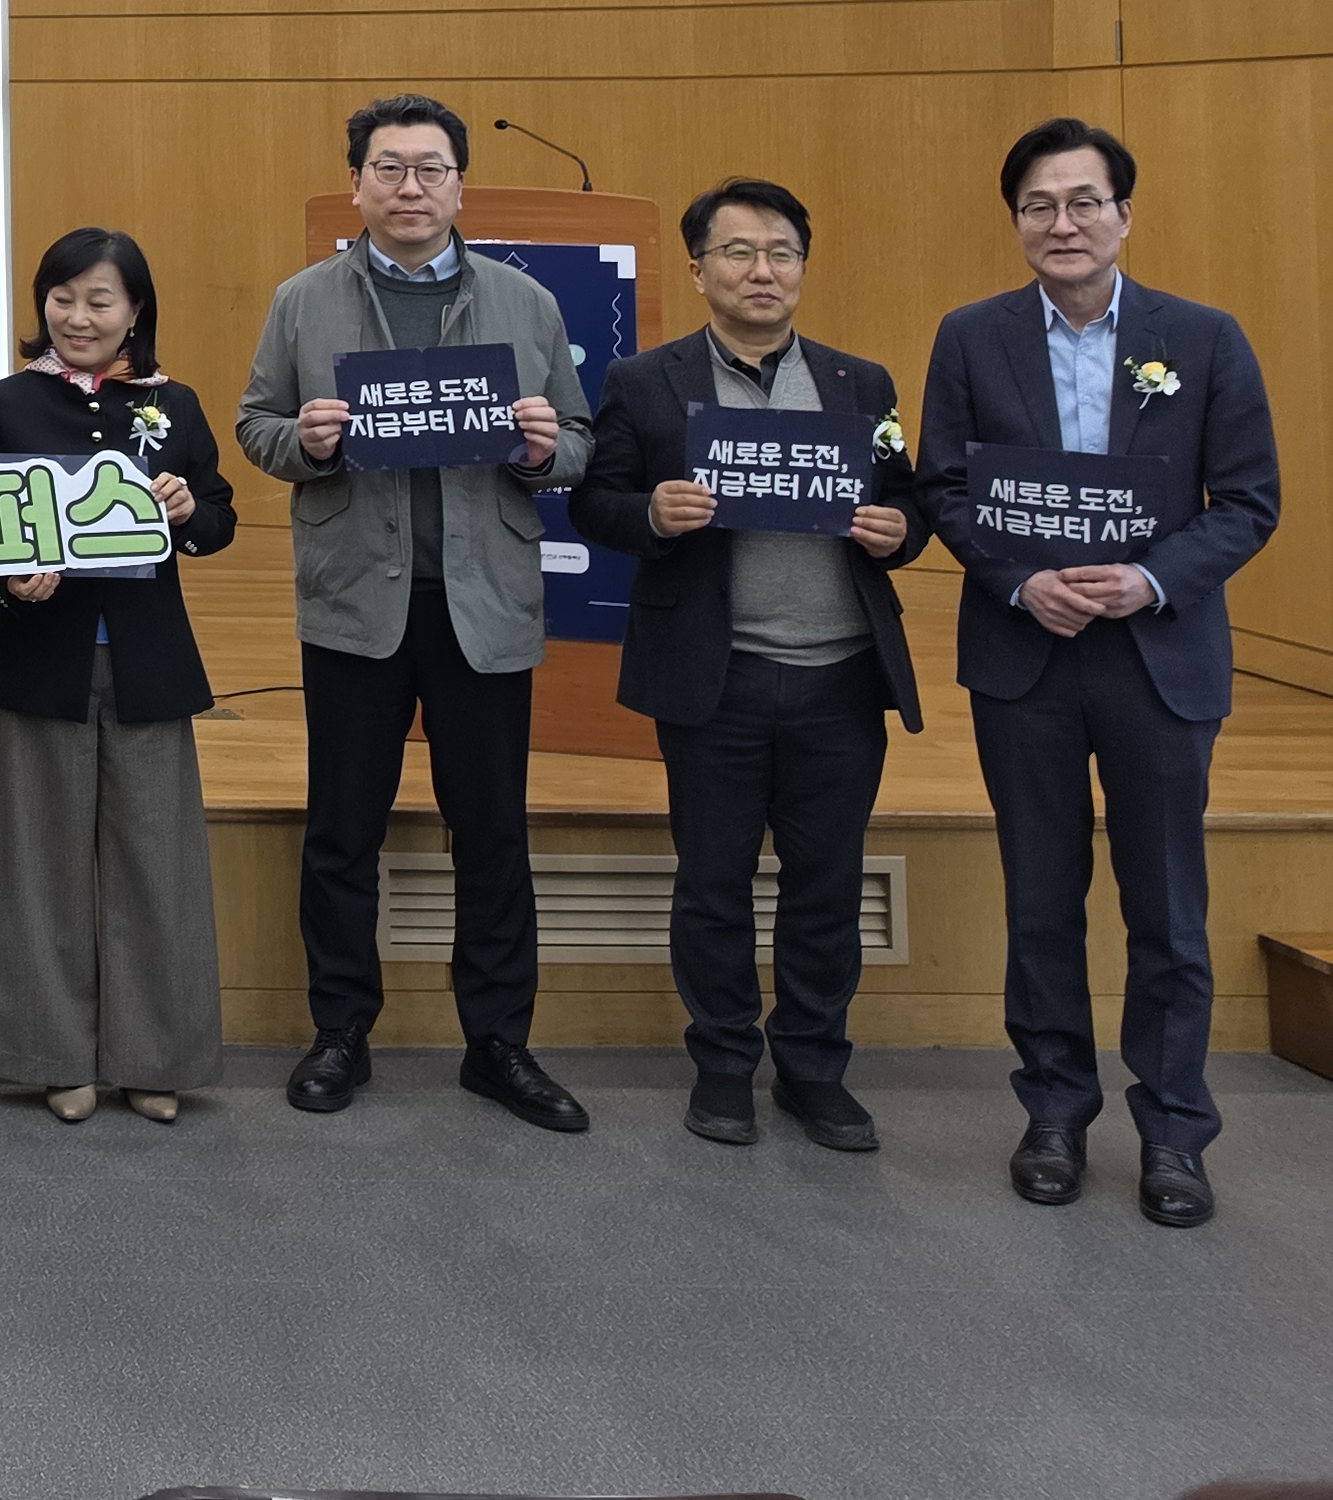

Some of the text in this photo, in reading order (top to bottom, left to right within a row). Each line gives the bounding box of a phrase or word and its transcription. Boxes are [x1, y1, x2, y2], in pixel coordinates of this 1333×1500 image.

[359, 376, 499, 407] 새로운 도전,
[349, 405, 516, 439] 지금부터 시작
[708, 438, 849, 473] 새로운 도전,
[692, 467, 865, 504] 지금부터 시작
[989, 477, 1145, 516] 새로운 도전,
[975, 503, 1158, 544] 지금부터 시작
